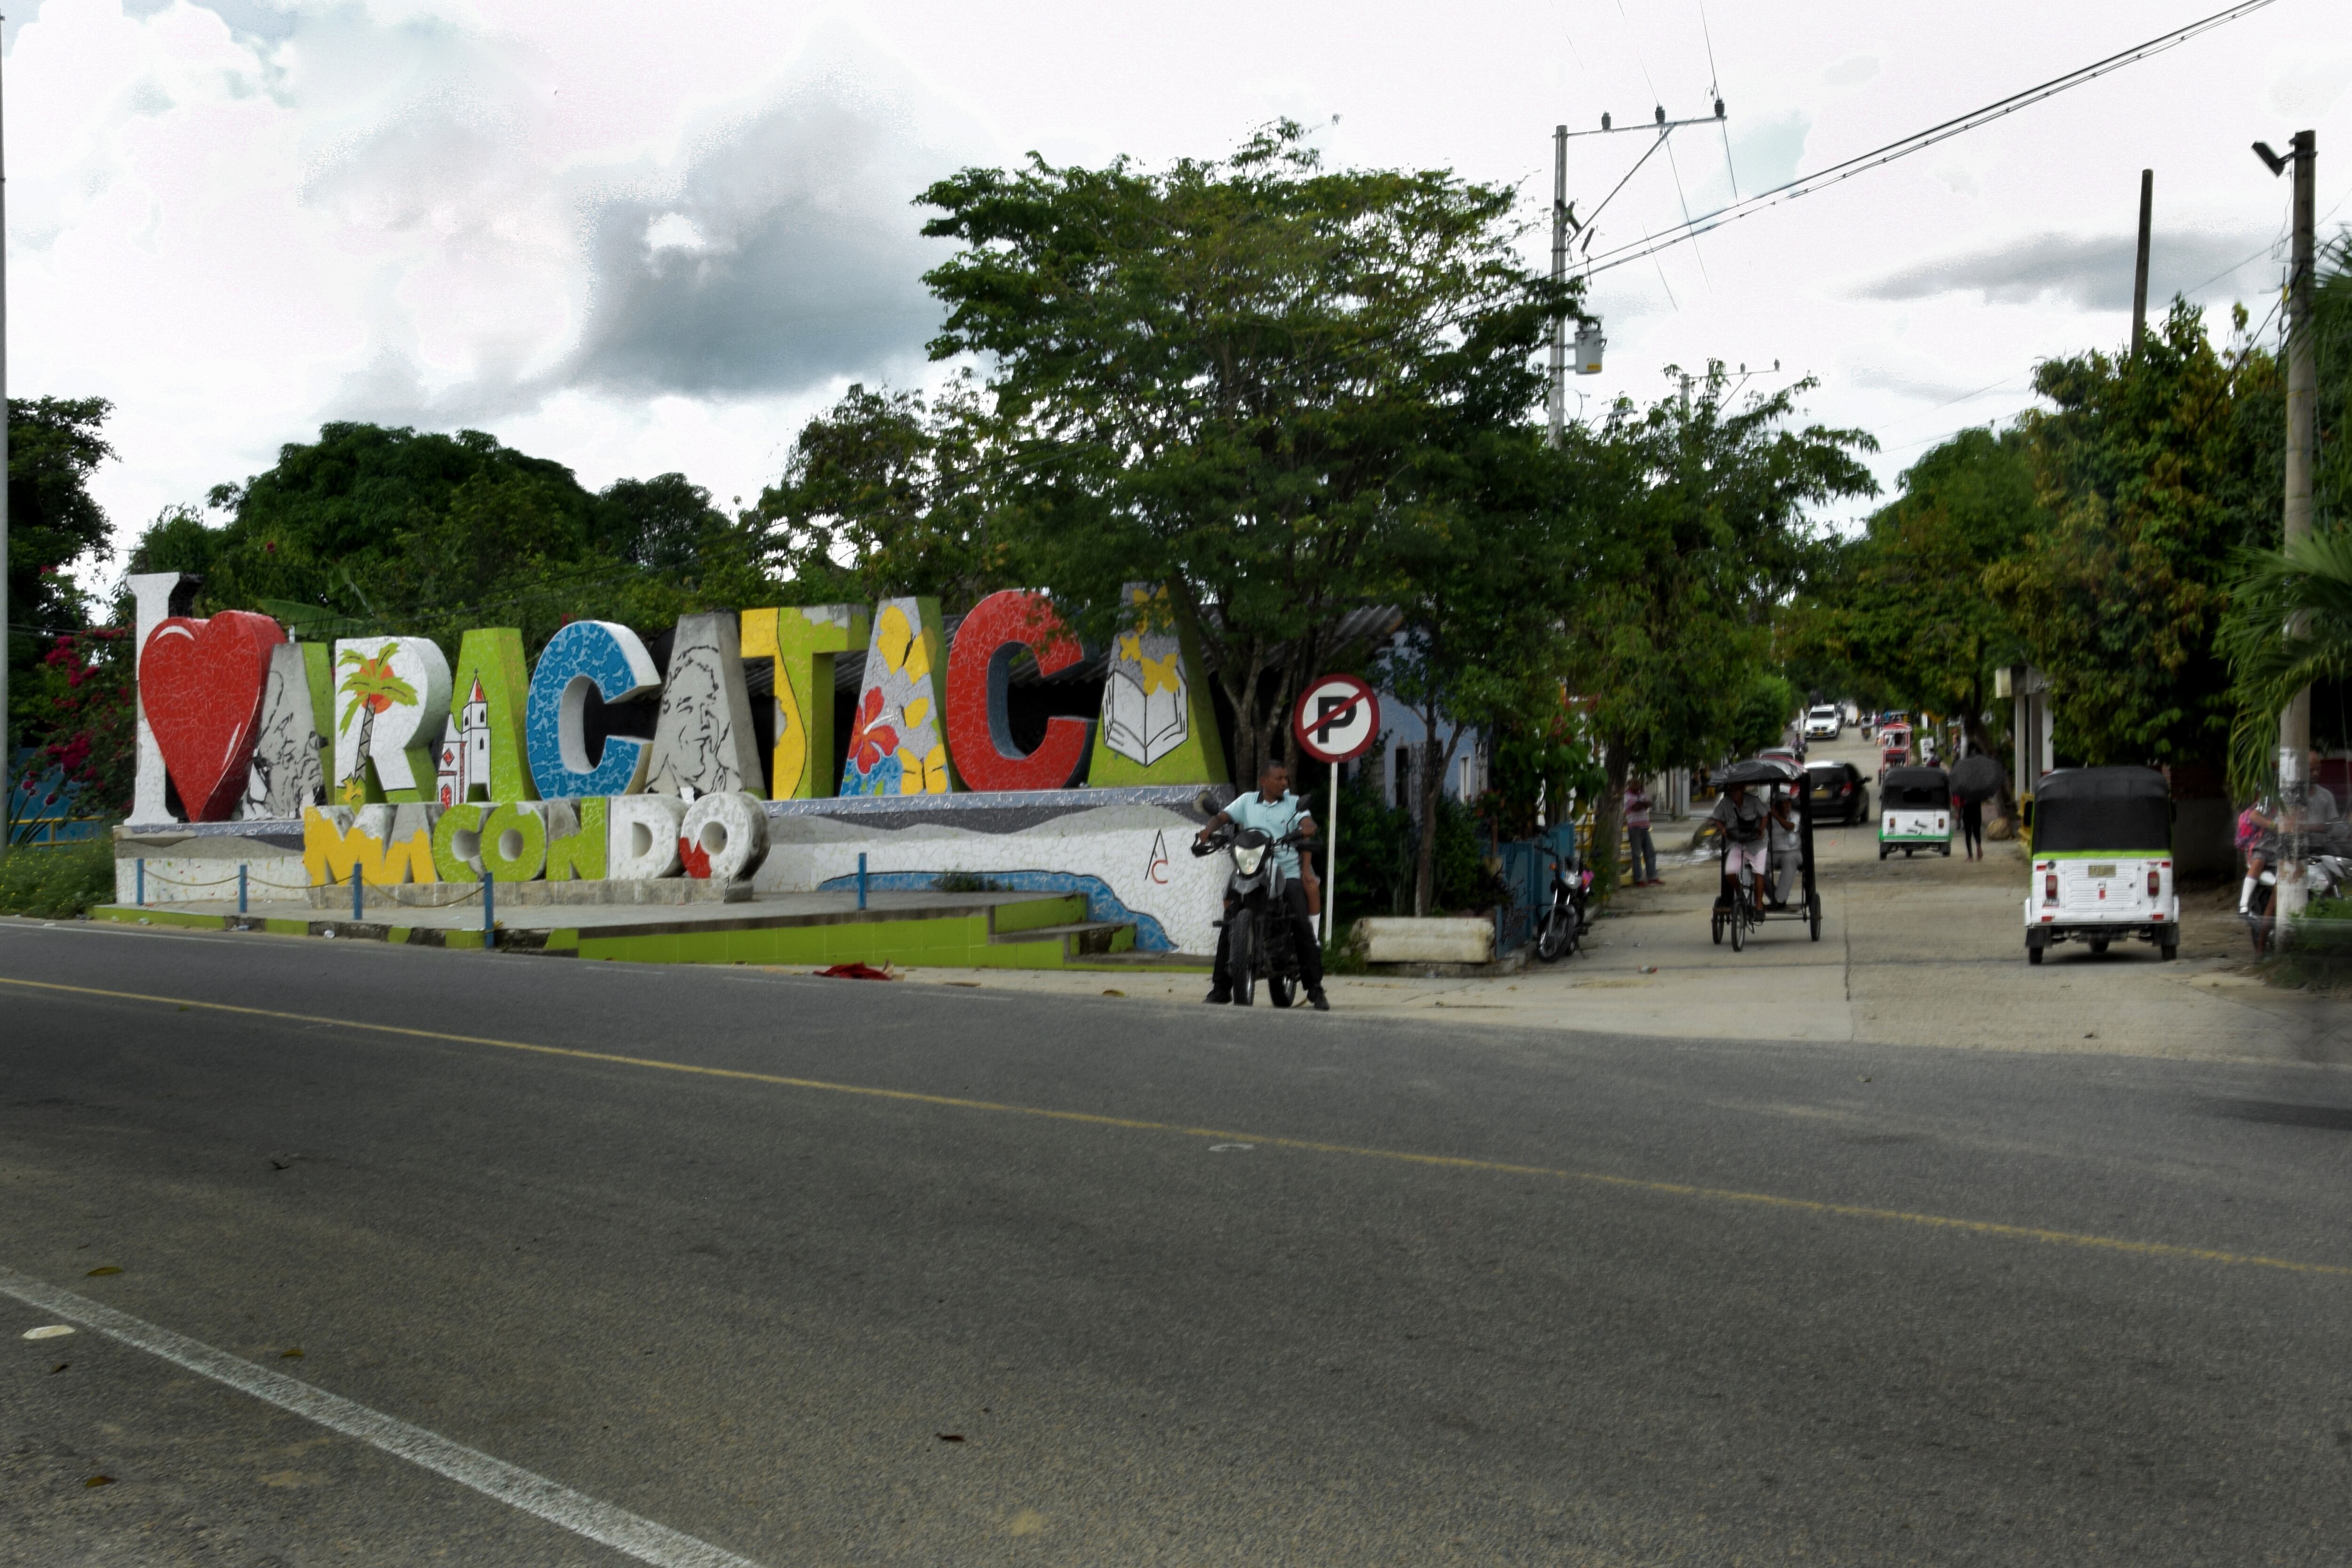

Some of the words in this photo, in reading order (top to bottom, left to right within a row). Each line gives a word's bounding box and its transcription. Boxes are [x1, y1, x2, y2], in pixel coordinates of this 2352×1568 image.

[123, 572, 181, 825] I
[238, 581, 1230, 822] ARACATACA
[1318, 696, 1357, 744] P
[303, 792, 770, 886] MACONDO
